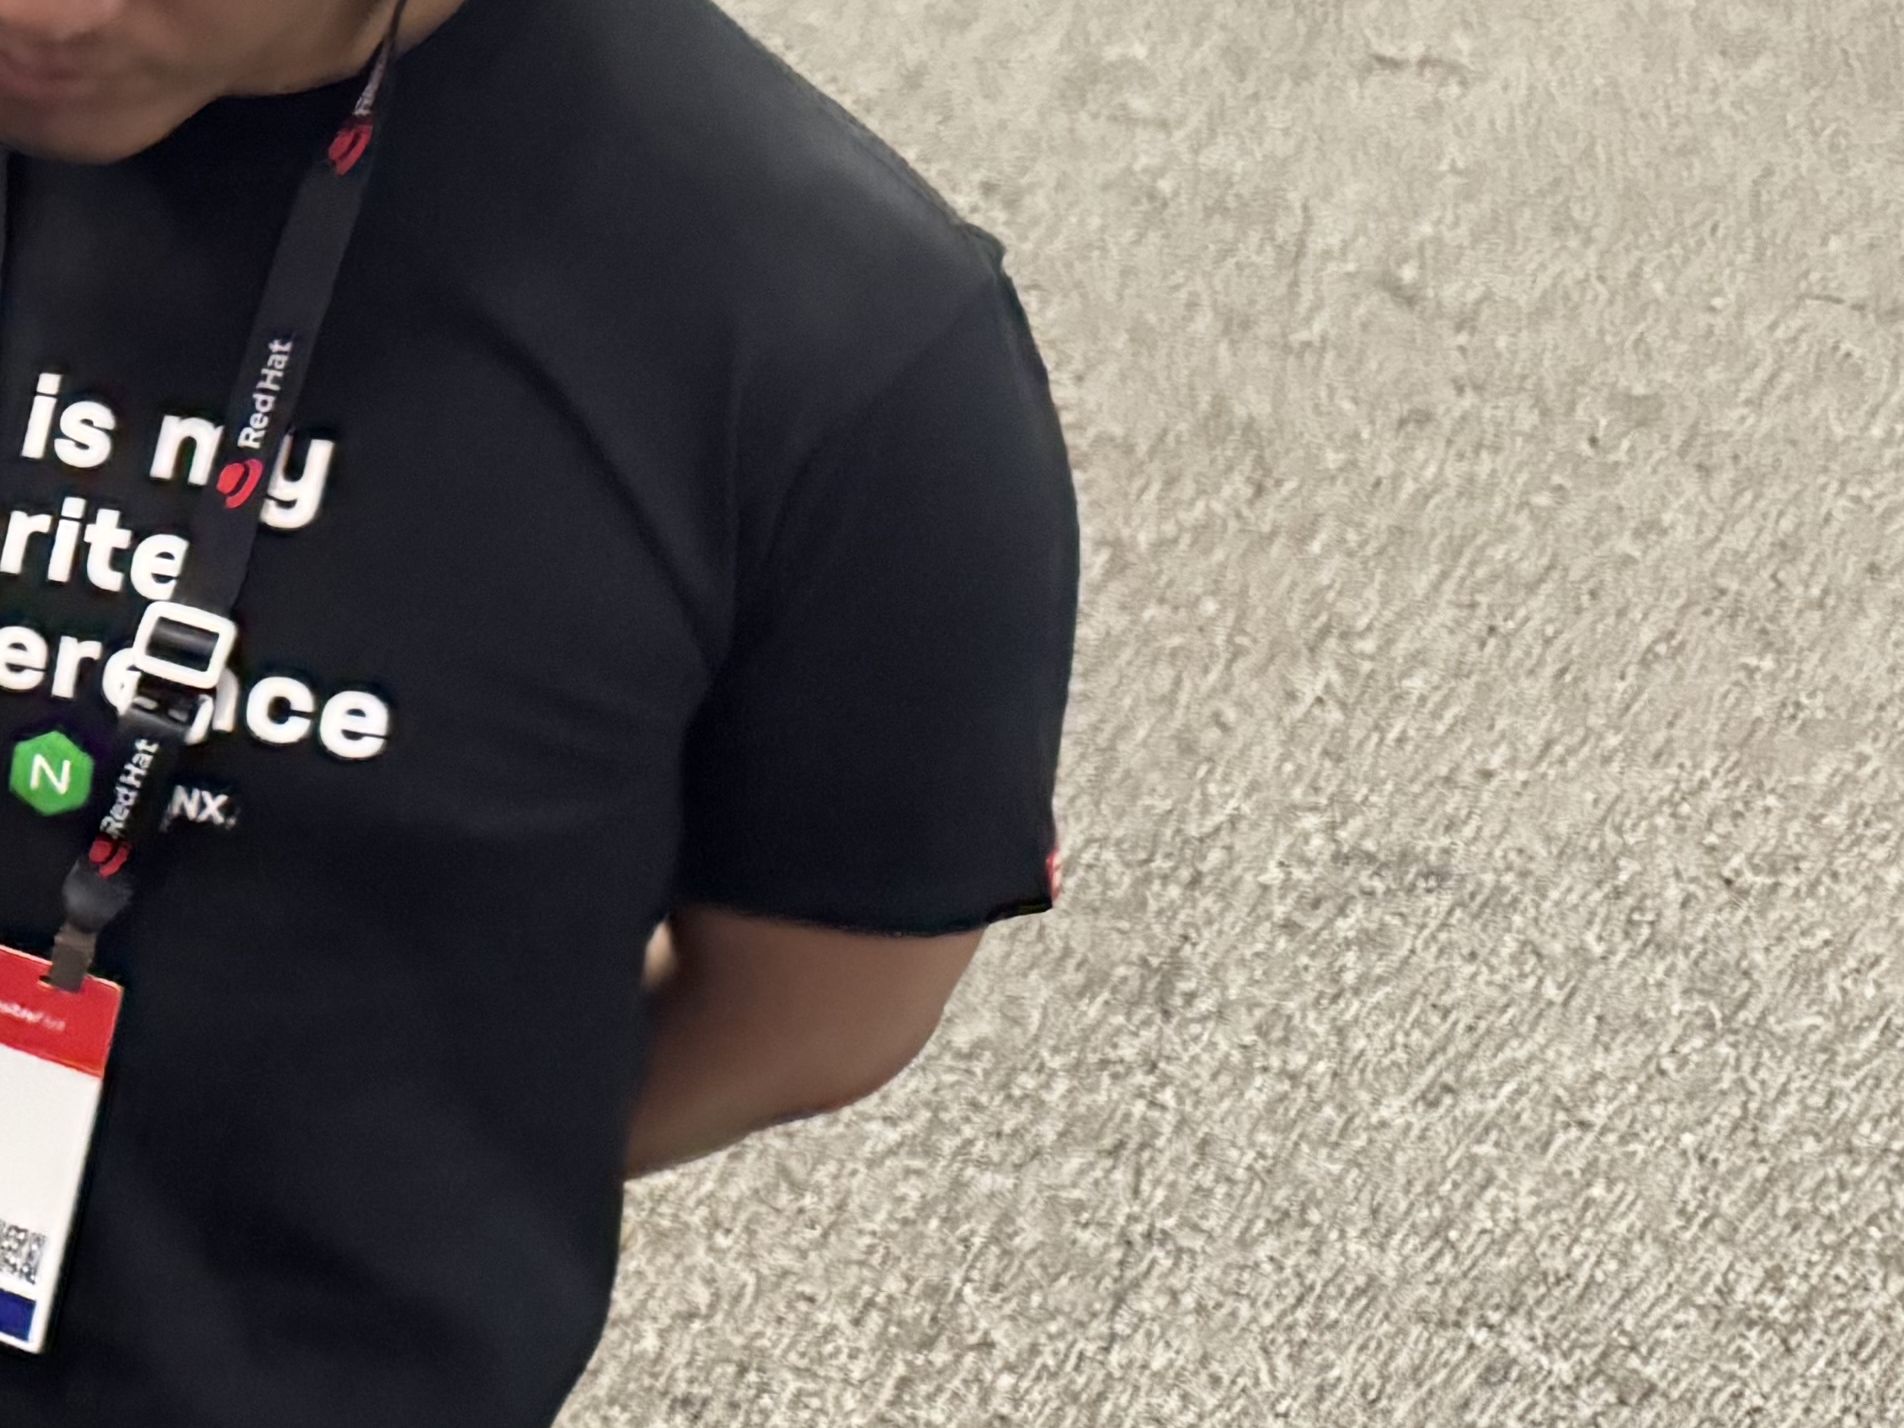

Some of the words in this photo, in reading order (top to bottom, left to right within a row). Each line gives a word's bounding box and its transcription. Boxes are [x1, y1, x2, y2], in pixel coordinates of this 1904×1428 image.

[255, 338, 293, 392] Hat
[20, 372, 117, 469] is
[237, 392, 276, 450] Red
[118, 737, 160, 789] Hat
[99, 785, 139, 840] Red
